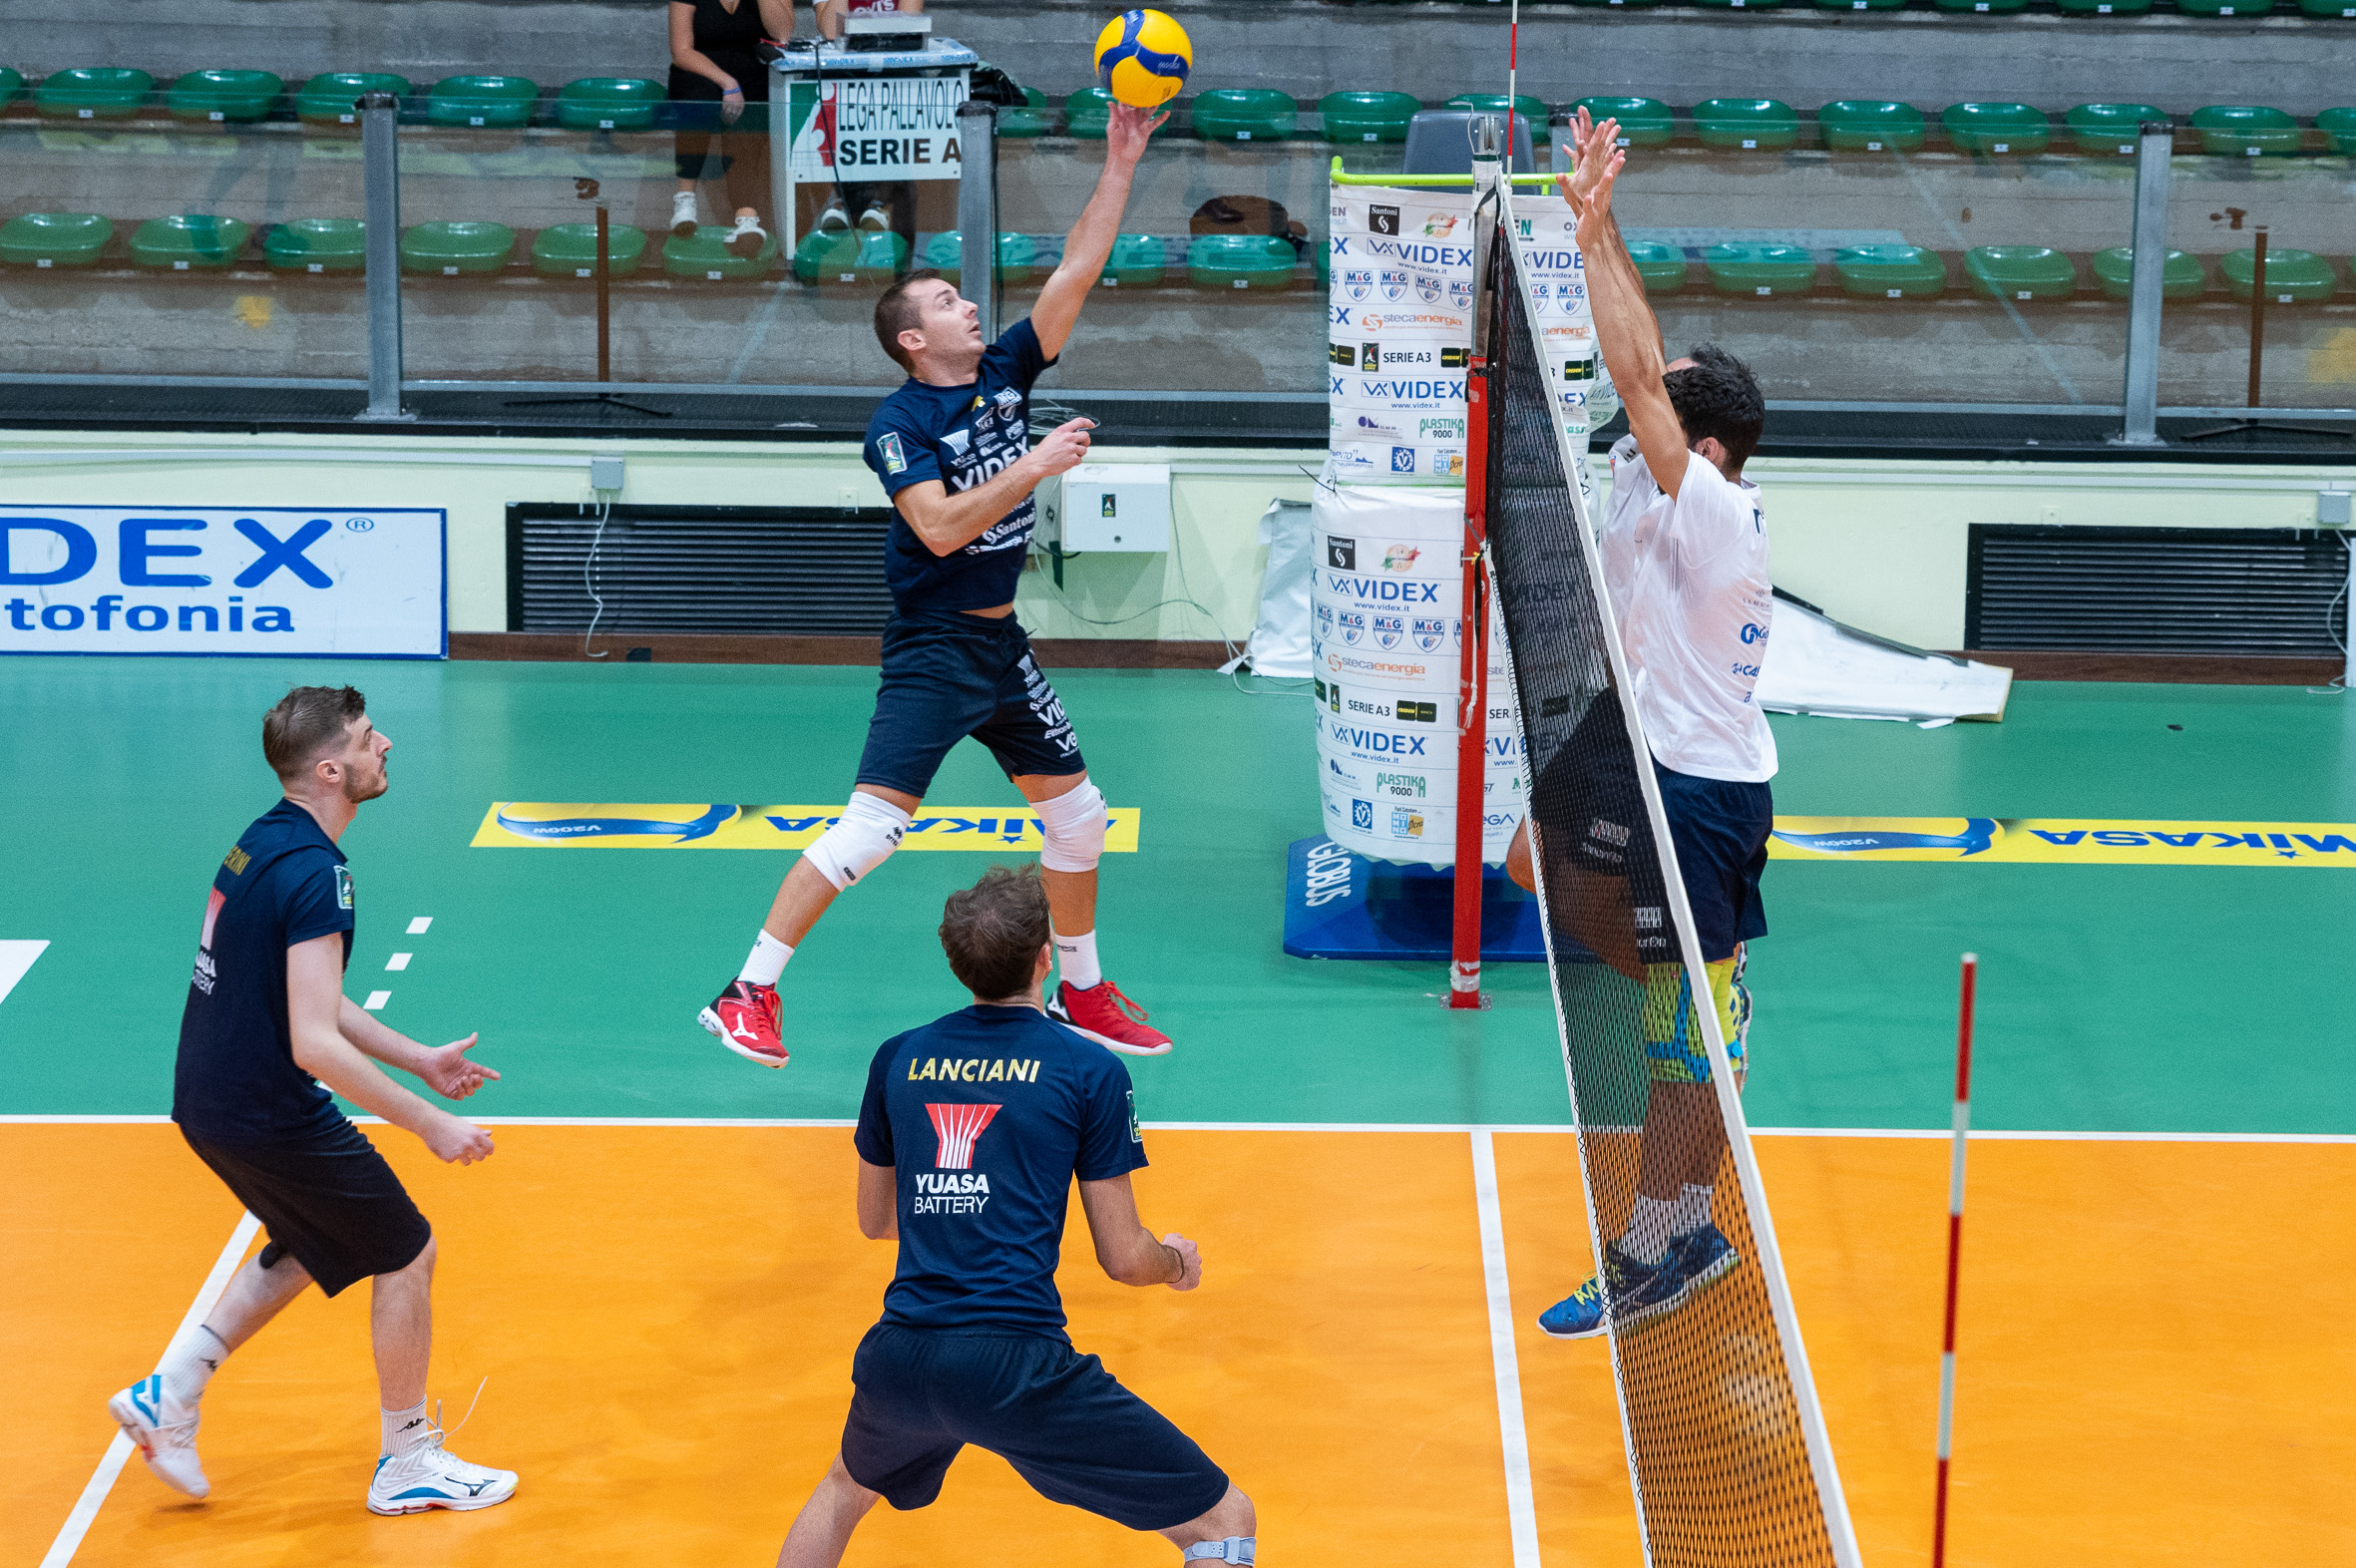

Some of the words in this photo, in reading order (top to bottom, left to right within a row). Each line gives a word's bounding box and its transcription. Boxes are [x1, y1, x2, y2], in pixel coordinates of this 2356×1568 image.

[839, 81, 877, 131] LEGA
[881, 80, 964, 131] PALLAVOLO
[839, 139, 931, 166] SERIE
[942, 138, 962, 164] A
[1371, 205, 1398, 216] Santoni
[1396, 242, 1473, 267] VIDEX
[1397, 261, 1447, 274] www.videx.it
[1382, 352, 1414, 363] SERIE
[1415, 352, 1431, 363] A3
[1391, 381, 1463, 399] VIDEX
[1432, 430, 1453, 439] 9000
[1329, 539, 1354, 549] Santoni
[1354, 578, 1438, 603] VIDEX
[5, 595, 295, 632] tofonia
[1354, 601, 1410, 612] www.videx.it
[1340, 612, 1364, 625] M&G
[1374, 617, 1402, 629] M&G
[1414, 620, 1443, 631] M&G
[1342, 655, 1425, 676] stecaenergia
[1348, 699, 1374, 714] SERIE
[1375, 705, 1390, 717] A3
[1351, 727, 1425, 756] VIDEX
[1351, 751, 1399, 764] www.videx.it
[1389, 786, 1412, 797] 9000
[1306, 842, 1352, 907] GLOBUS
[908, 1057, 1041, 1083] LANCIANI
[916, 1173, 990, 1195] YUASA
[914, 1196, 990, 1215] BATTERY
